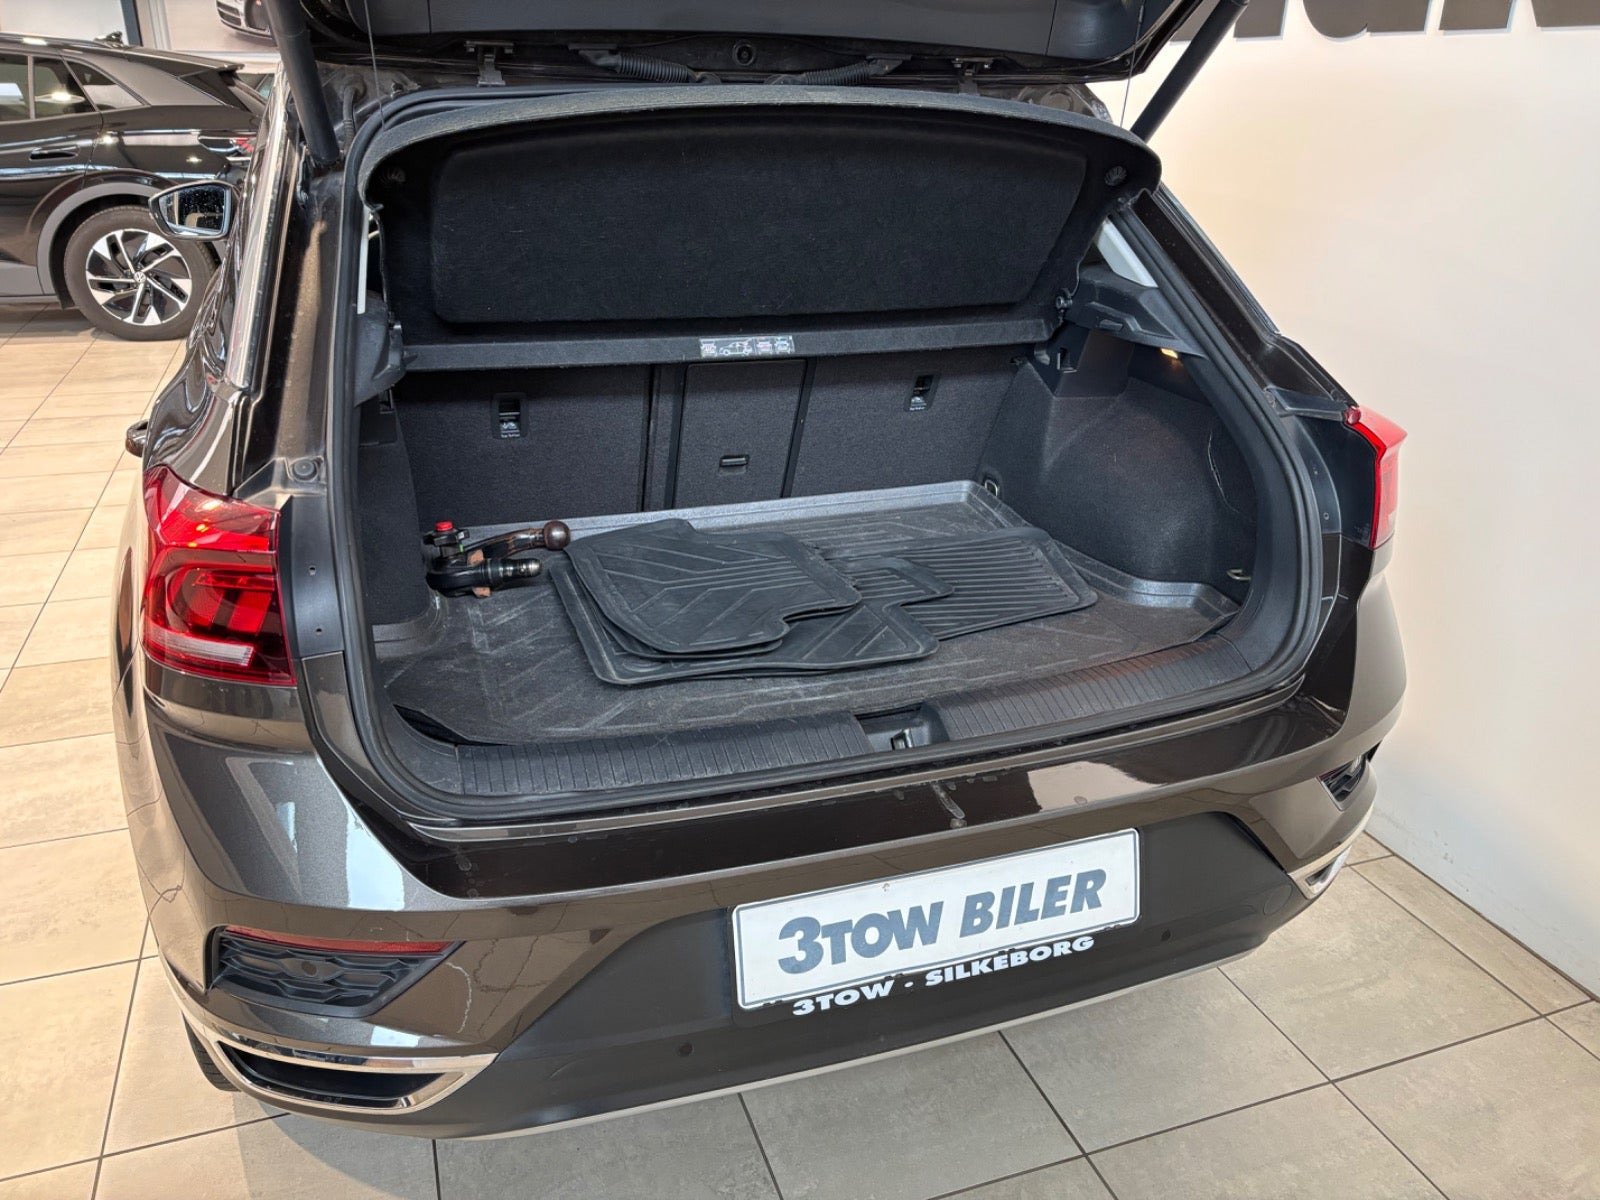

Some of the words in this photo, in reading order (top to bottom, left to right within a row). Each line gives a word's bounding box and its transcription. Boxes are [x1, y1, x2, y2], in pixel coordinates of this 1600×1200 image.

[778, 901, 944, 975] 3TOW
[959, 868, 1107, 938] BILER
[792, 979, 895, 1015] 3TOW
[925, 935, 1095, 987] SILKEBORG
